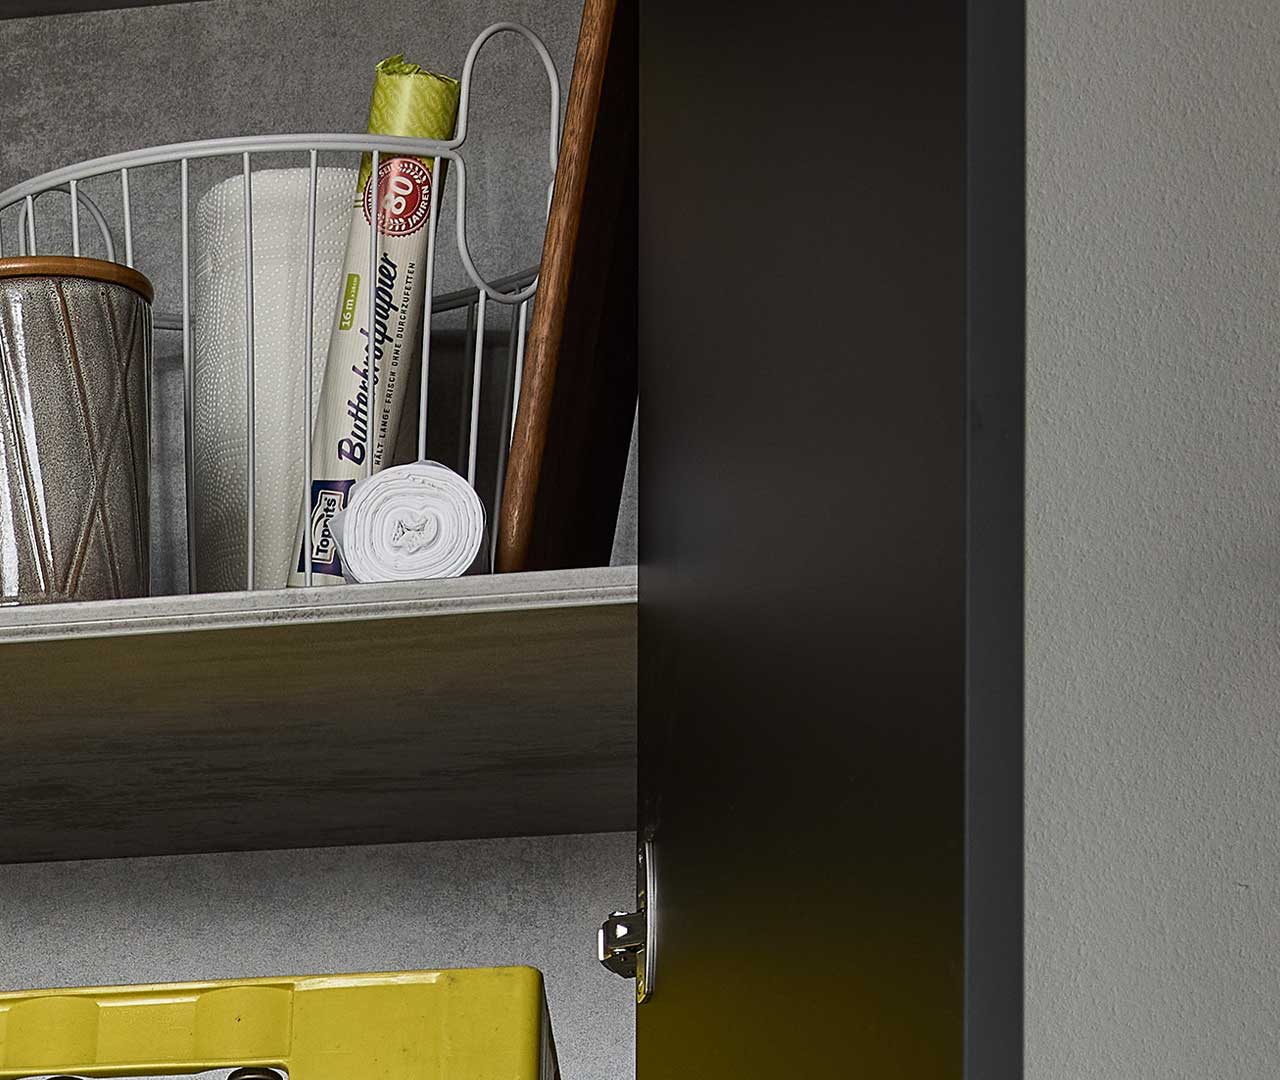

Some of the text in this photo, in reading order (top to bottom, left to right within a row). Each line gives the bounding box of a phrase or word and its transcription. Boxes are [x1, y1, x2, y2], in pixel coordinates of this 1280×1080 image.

[383, 176, 414, 215] 80
[408, 185, 429, 227] JAHREN
[341, 312, 352, 327] 16
[345, 299, 354, 310] m
[374, 262, 416, 465] HÄLT LANGE FRISCH OHNE DURCHZUFETTEN
